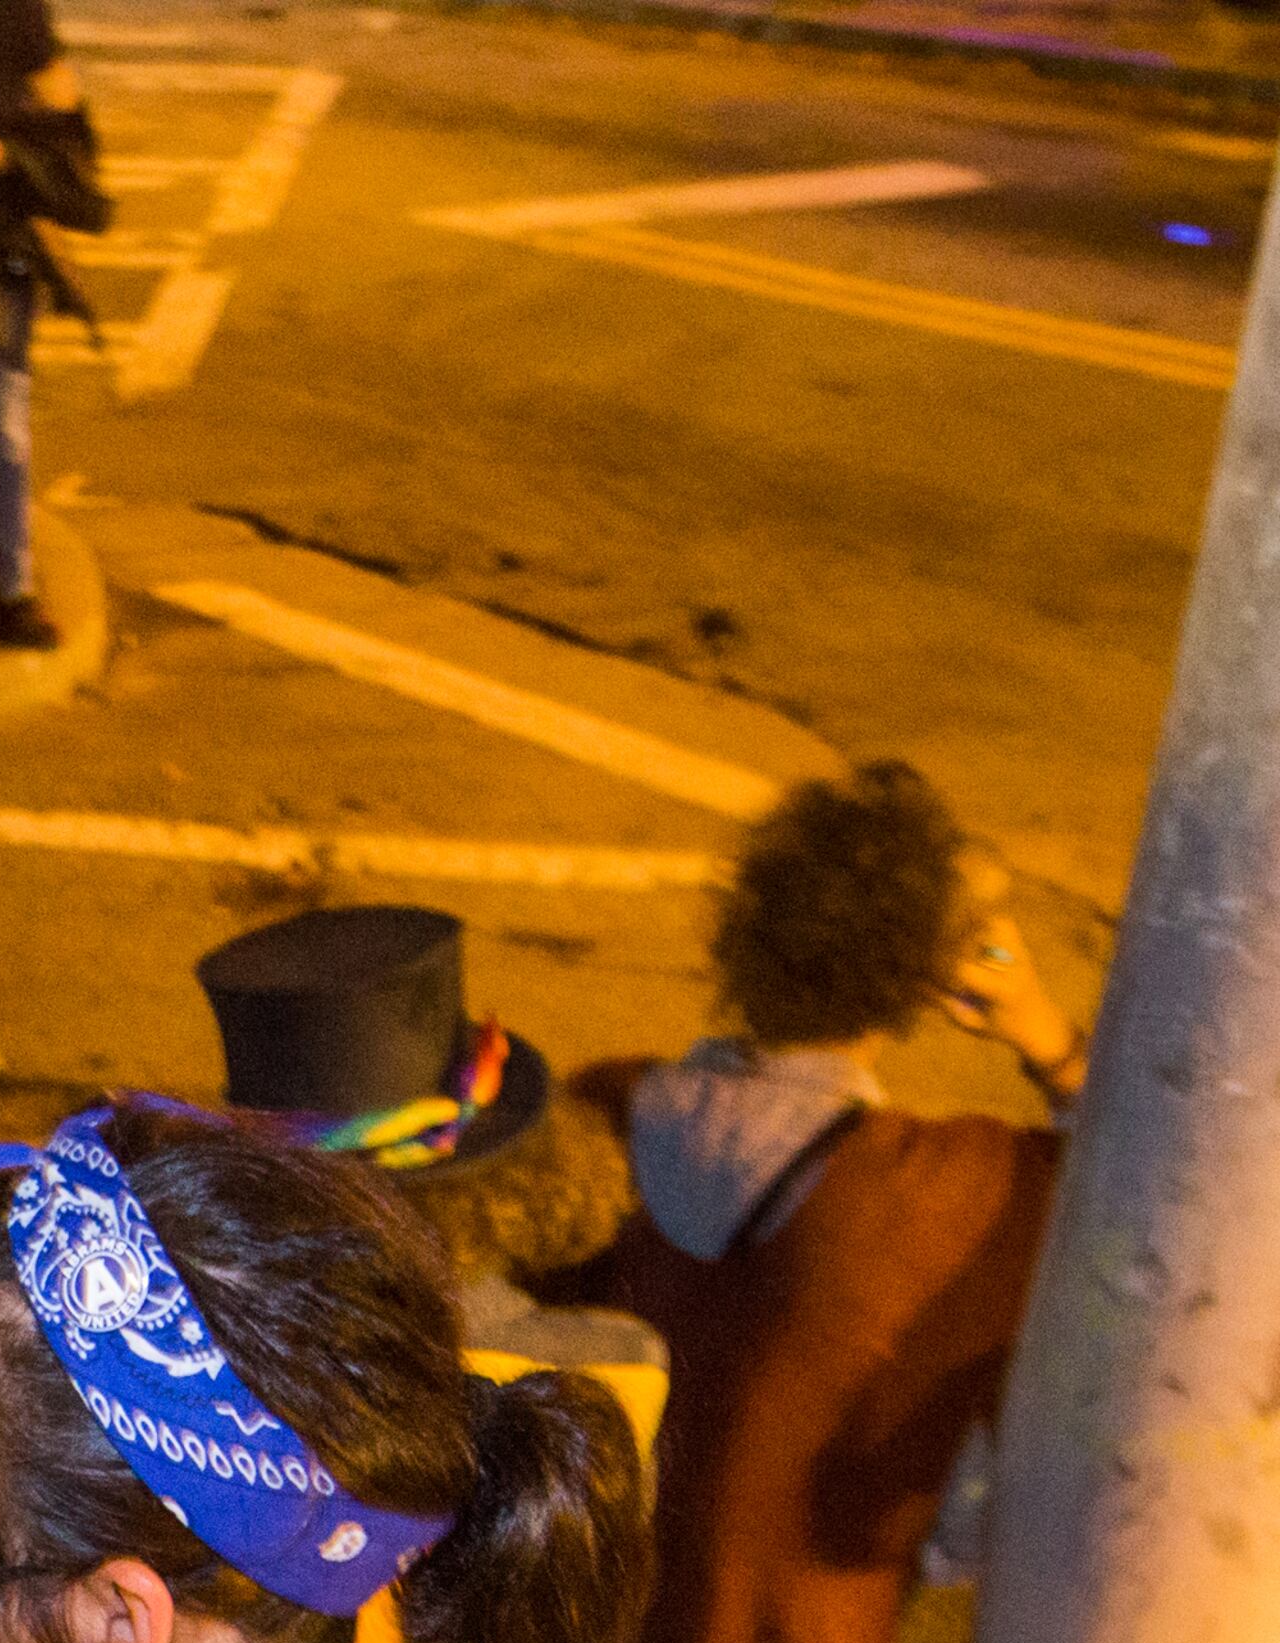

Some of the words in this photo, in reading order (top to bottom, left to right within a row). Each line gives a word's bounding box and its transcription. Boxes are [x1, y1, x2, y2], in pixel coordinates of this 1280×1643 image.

[61, 1238, 128, 1279] ABRAMS
[82, 1257, 126, 1314] A
[79, 1292, 140, 1330] UNITED
